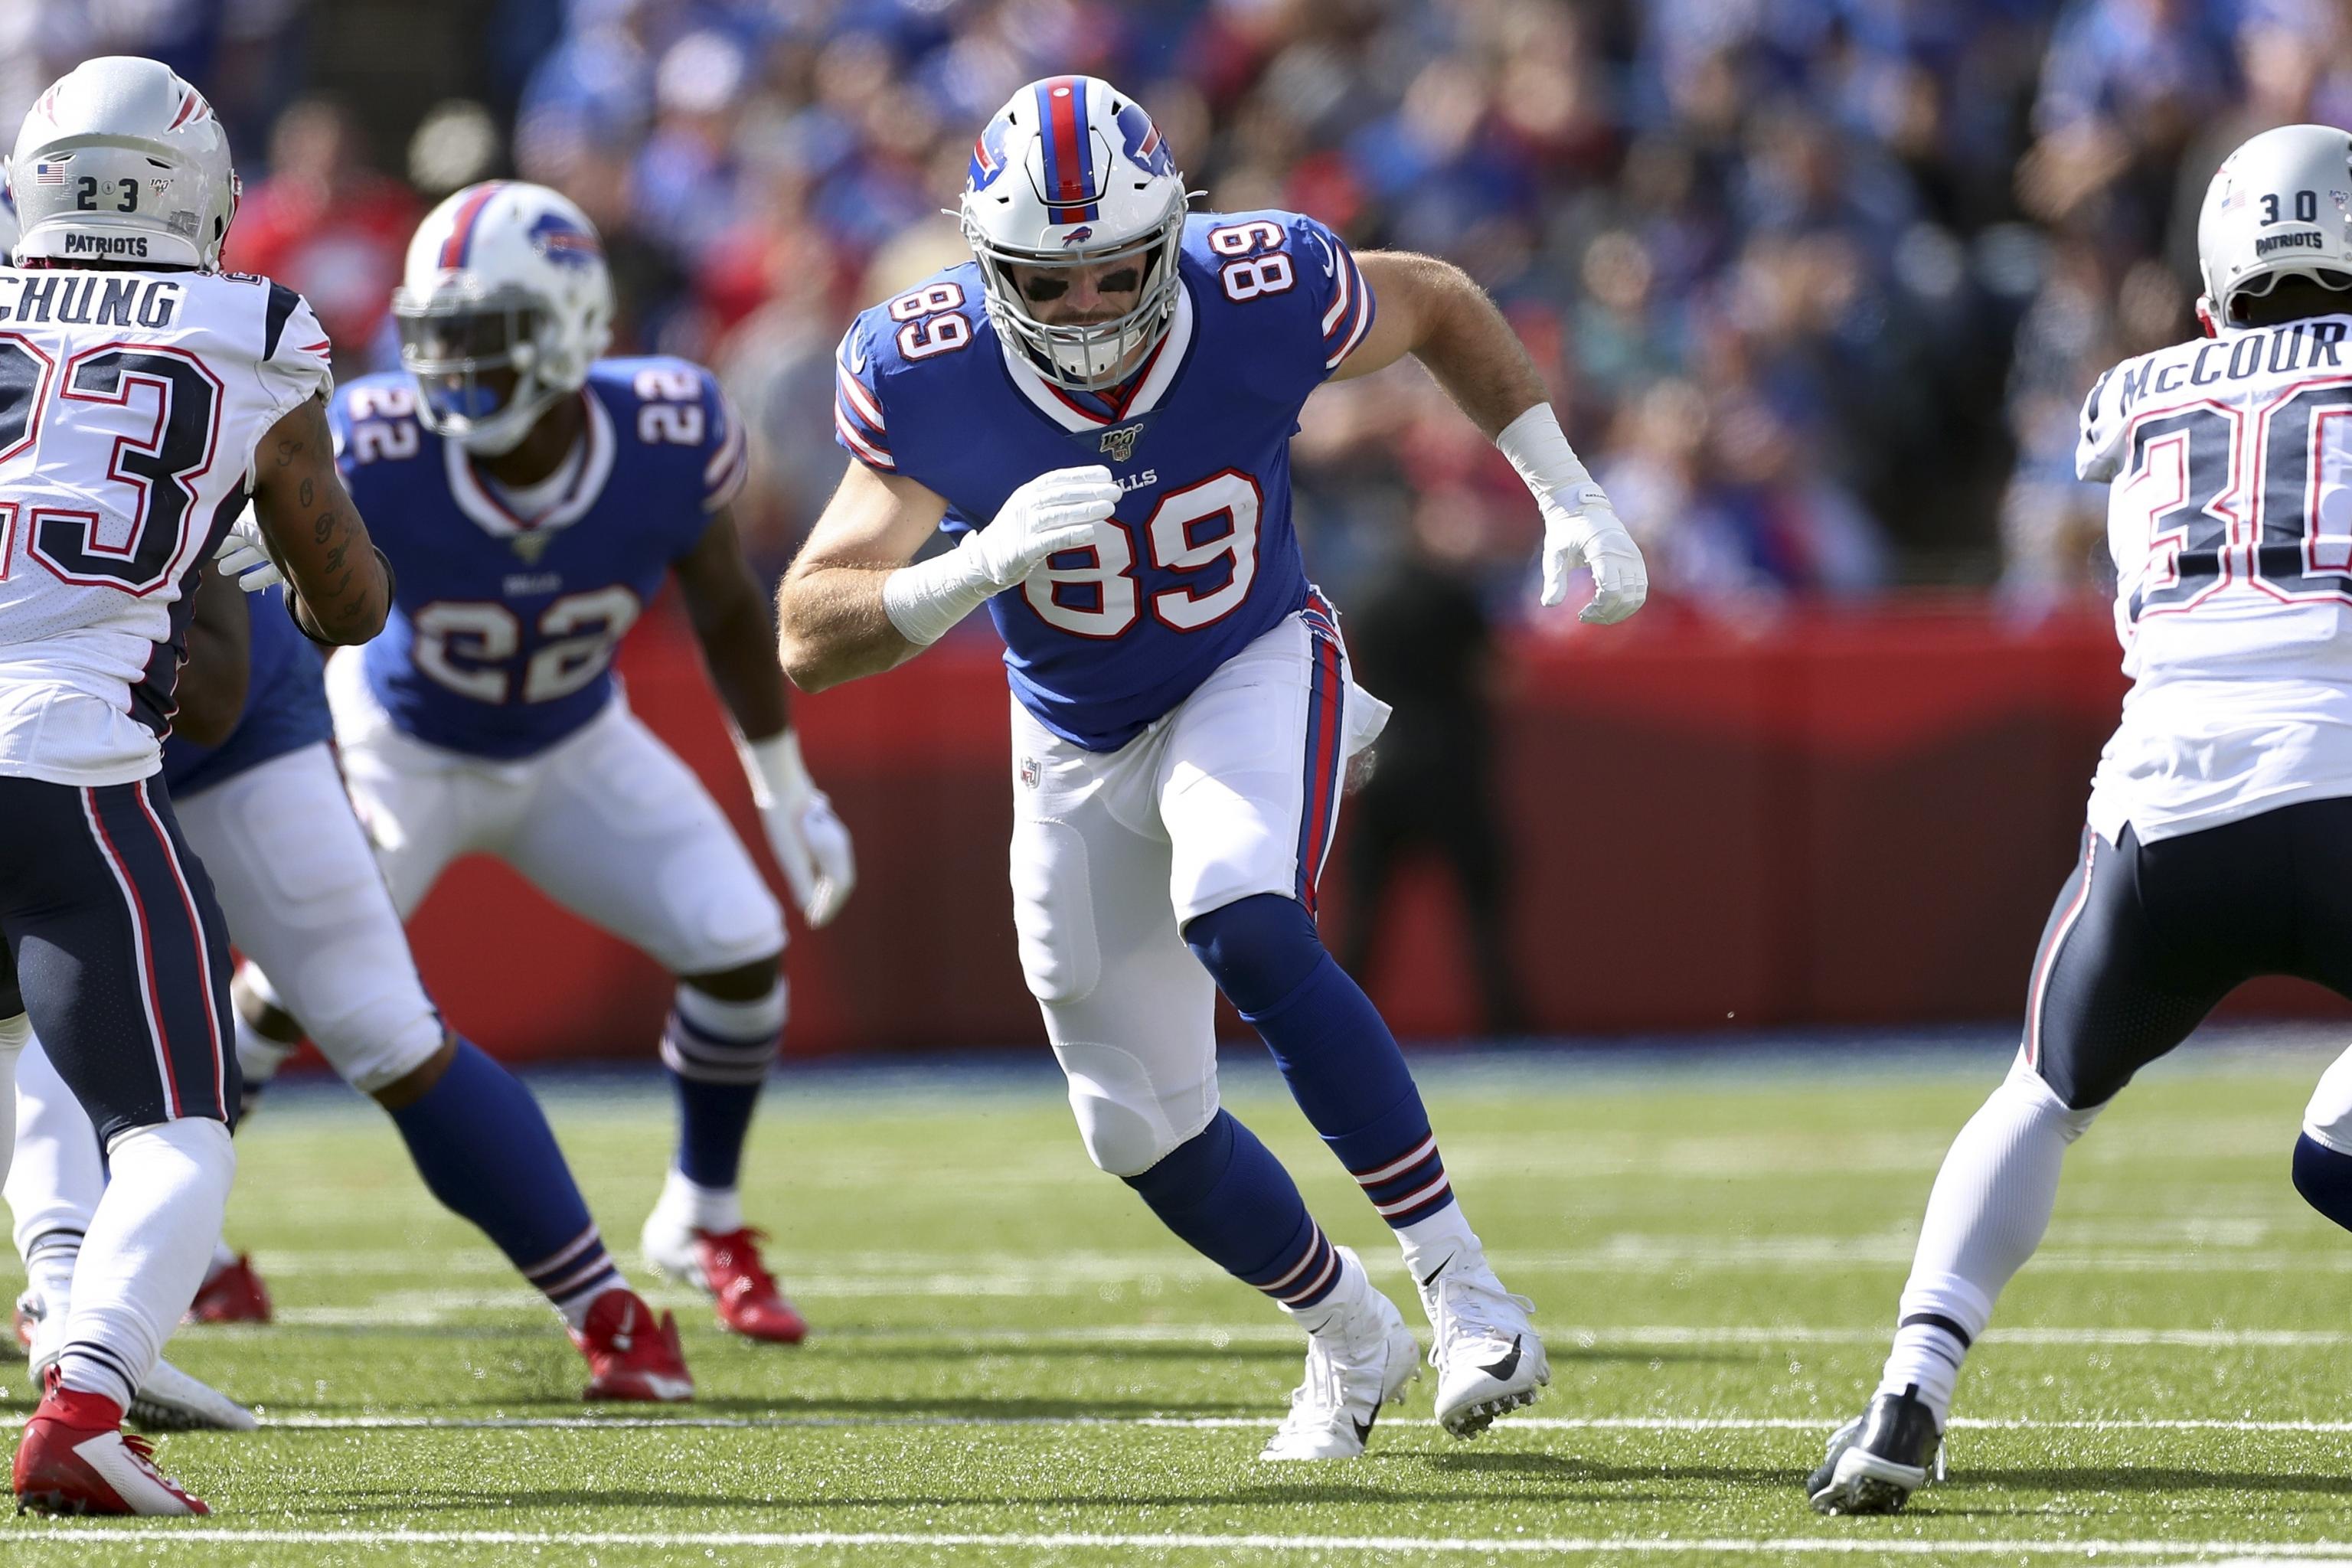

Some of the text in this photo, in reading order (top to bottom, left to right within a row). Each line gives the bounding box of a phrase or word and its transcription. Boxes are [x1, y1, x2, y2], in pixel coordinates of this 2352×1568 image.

[65, 233, 148, 257] PATRIOTS
[1207, 220, 1297, 304] 89
[2256, 231, 2322, 257] PATRIOTS
[888, 282, 971, 362] 89
[348, 387, 420, 465] 22
[634, 368, 704, 446] 22
[2124, 376, 2352, 625] 30
[1020, 466, 1264, 641] 89
